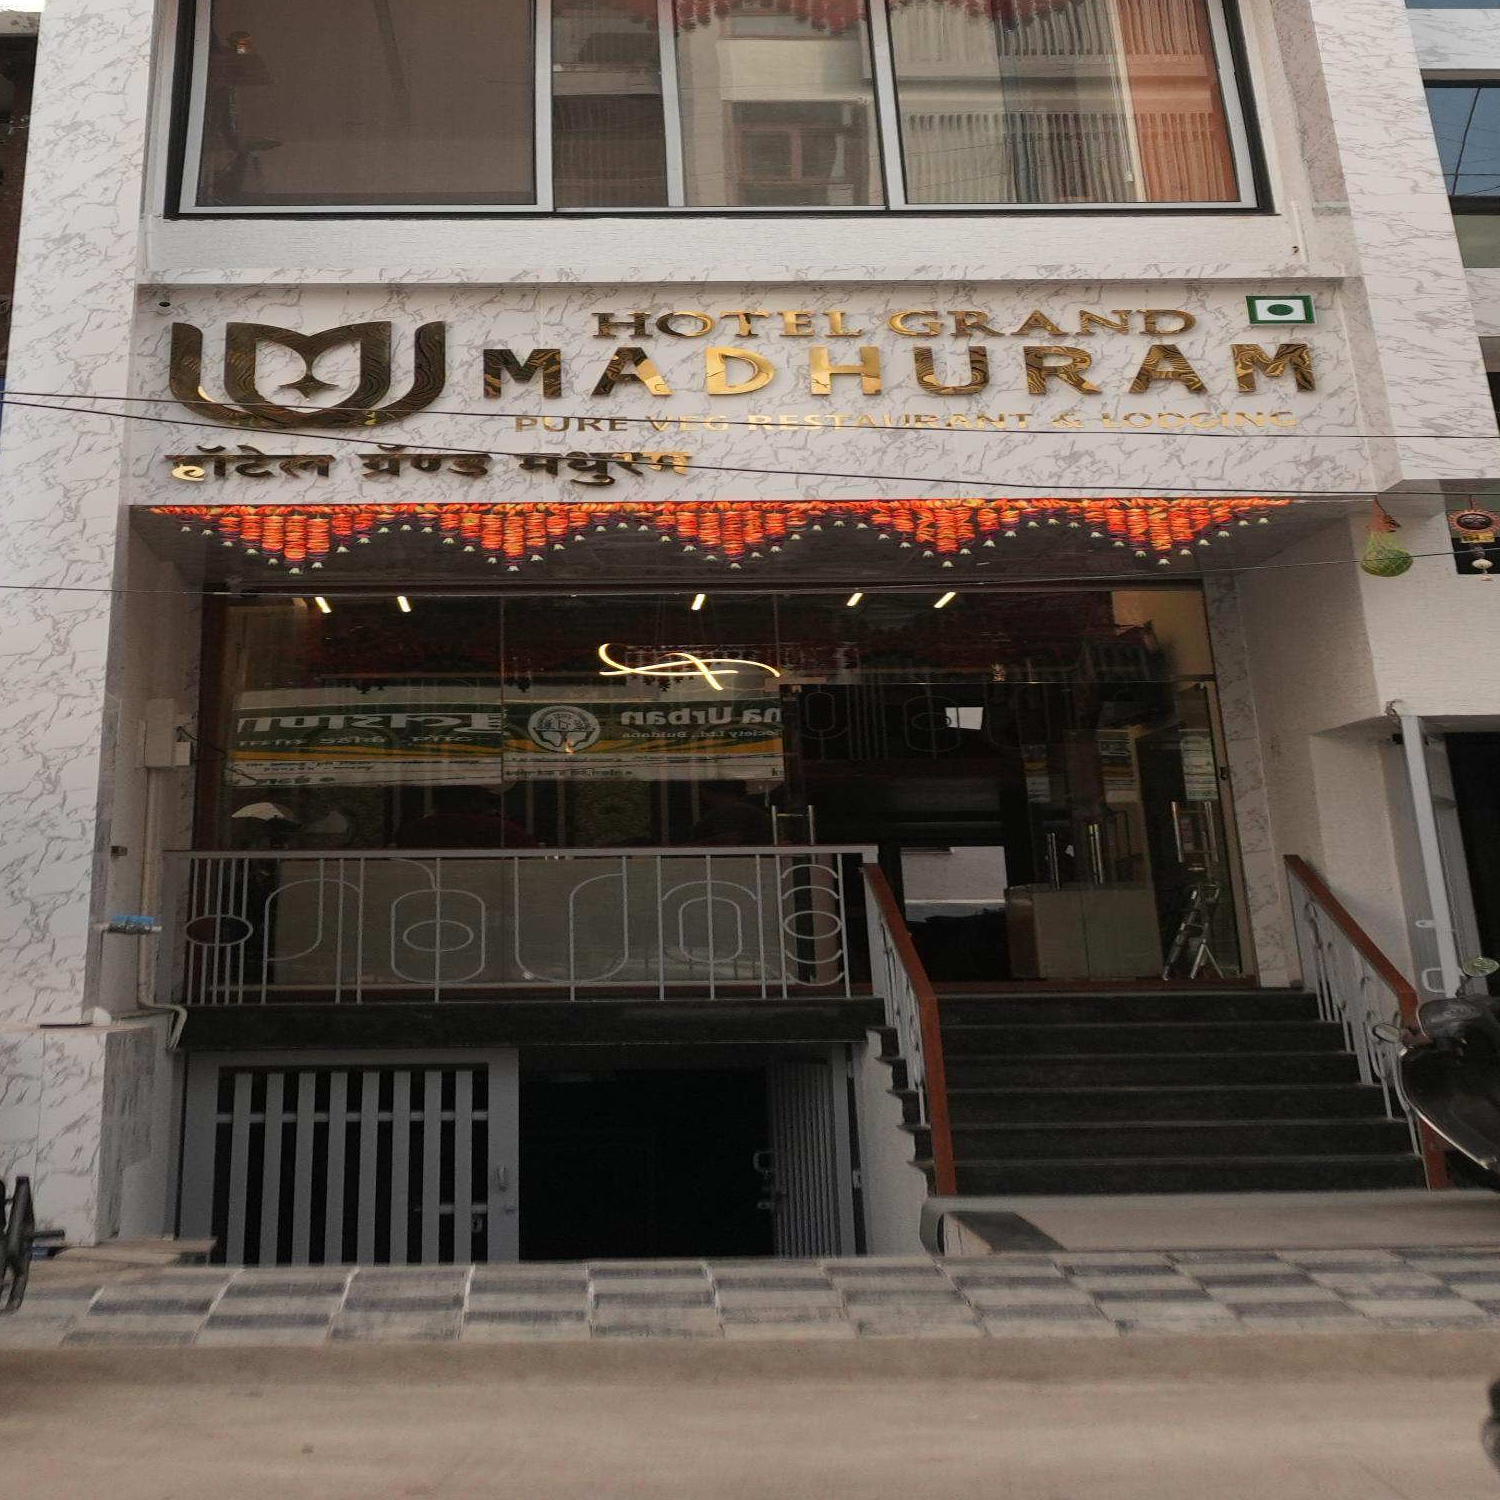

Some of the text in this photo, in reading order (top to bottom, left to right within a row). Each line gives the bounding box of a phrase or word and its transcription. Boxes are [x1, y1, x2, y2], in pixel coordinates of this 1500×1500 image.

[590, 307, 1198, 338] HOTEL GRAND
[482, 342, 1318, 399] MADHURAM
[515, 411, 1297, 433] PURE VEG RESTAURANT & LODGING
[164, 442, 336, 482] हॉटेल
[518, 451, 693, 486] मधुरम
